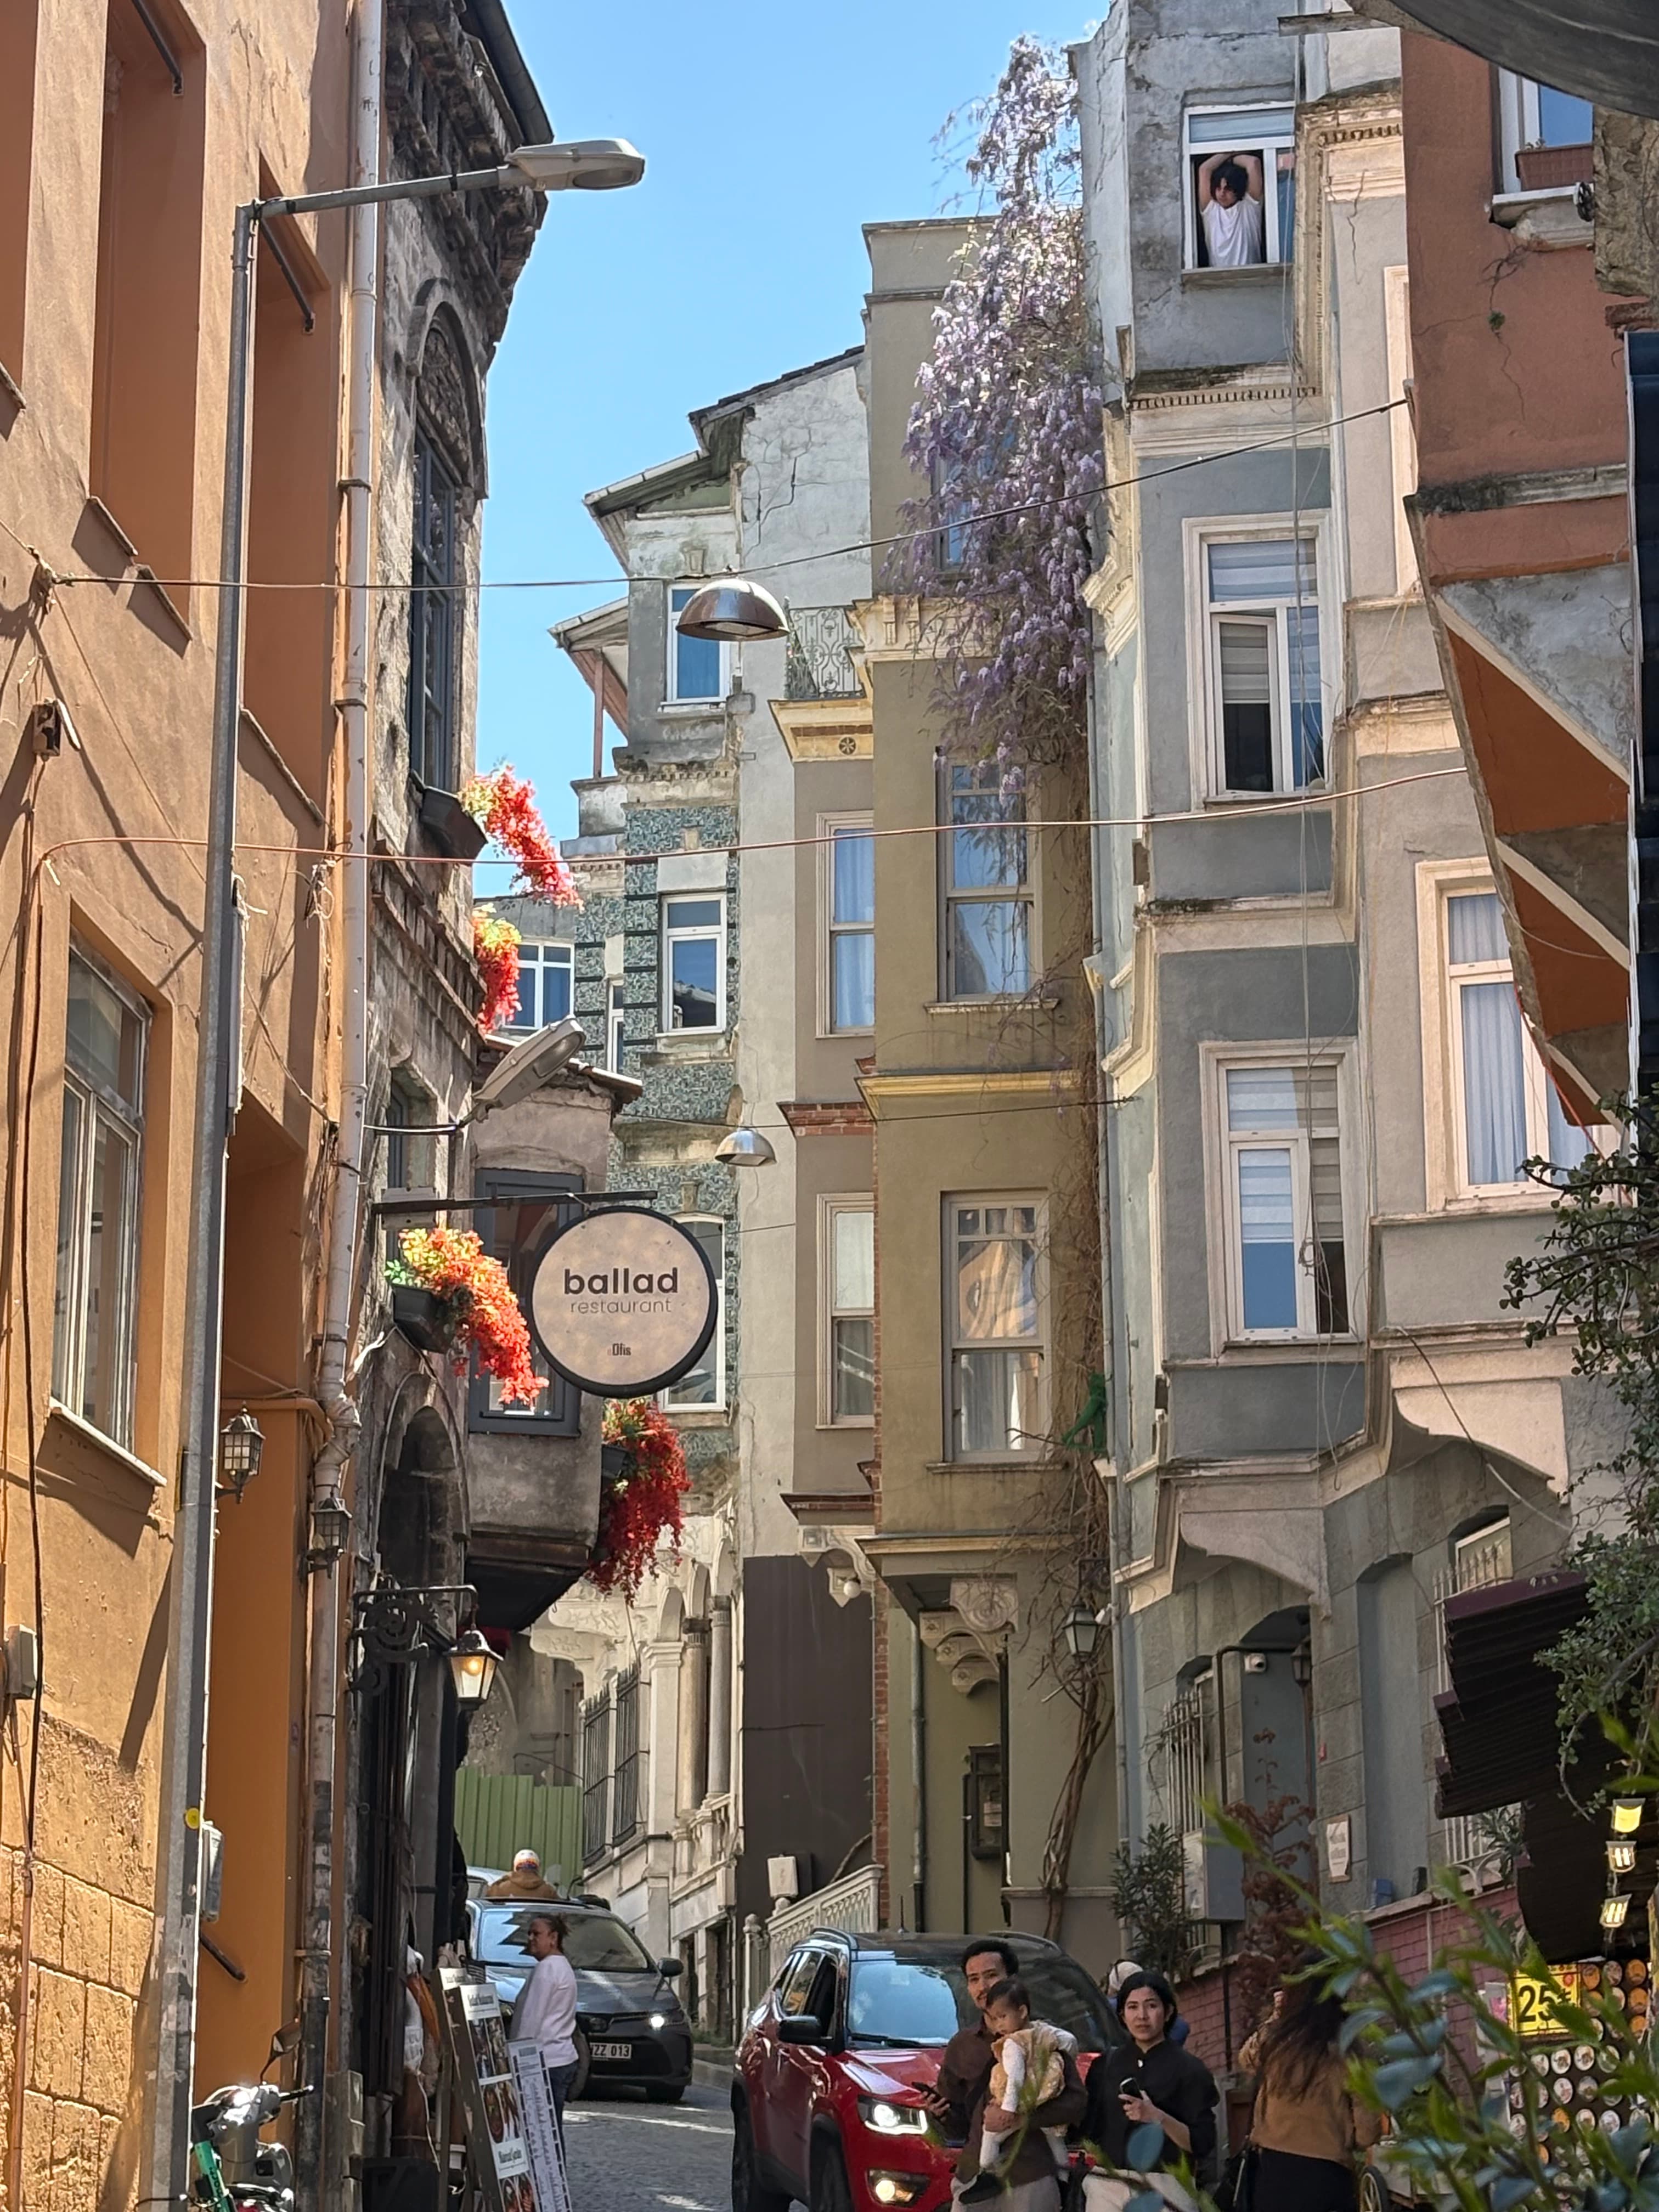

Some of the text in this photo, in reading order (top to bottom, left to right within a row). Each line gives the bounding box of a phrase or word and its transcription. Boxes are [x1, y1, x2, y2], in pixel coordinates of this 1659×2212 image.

[565, 1267, 678, 1295] ballad
[571, 1299, 672, 1314] restaurant
[611, 2045, 629, 2057] 013
